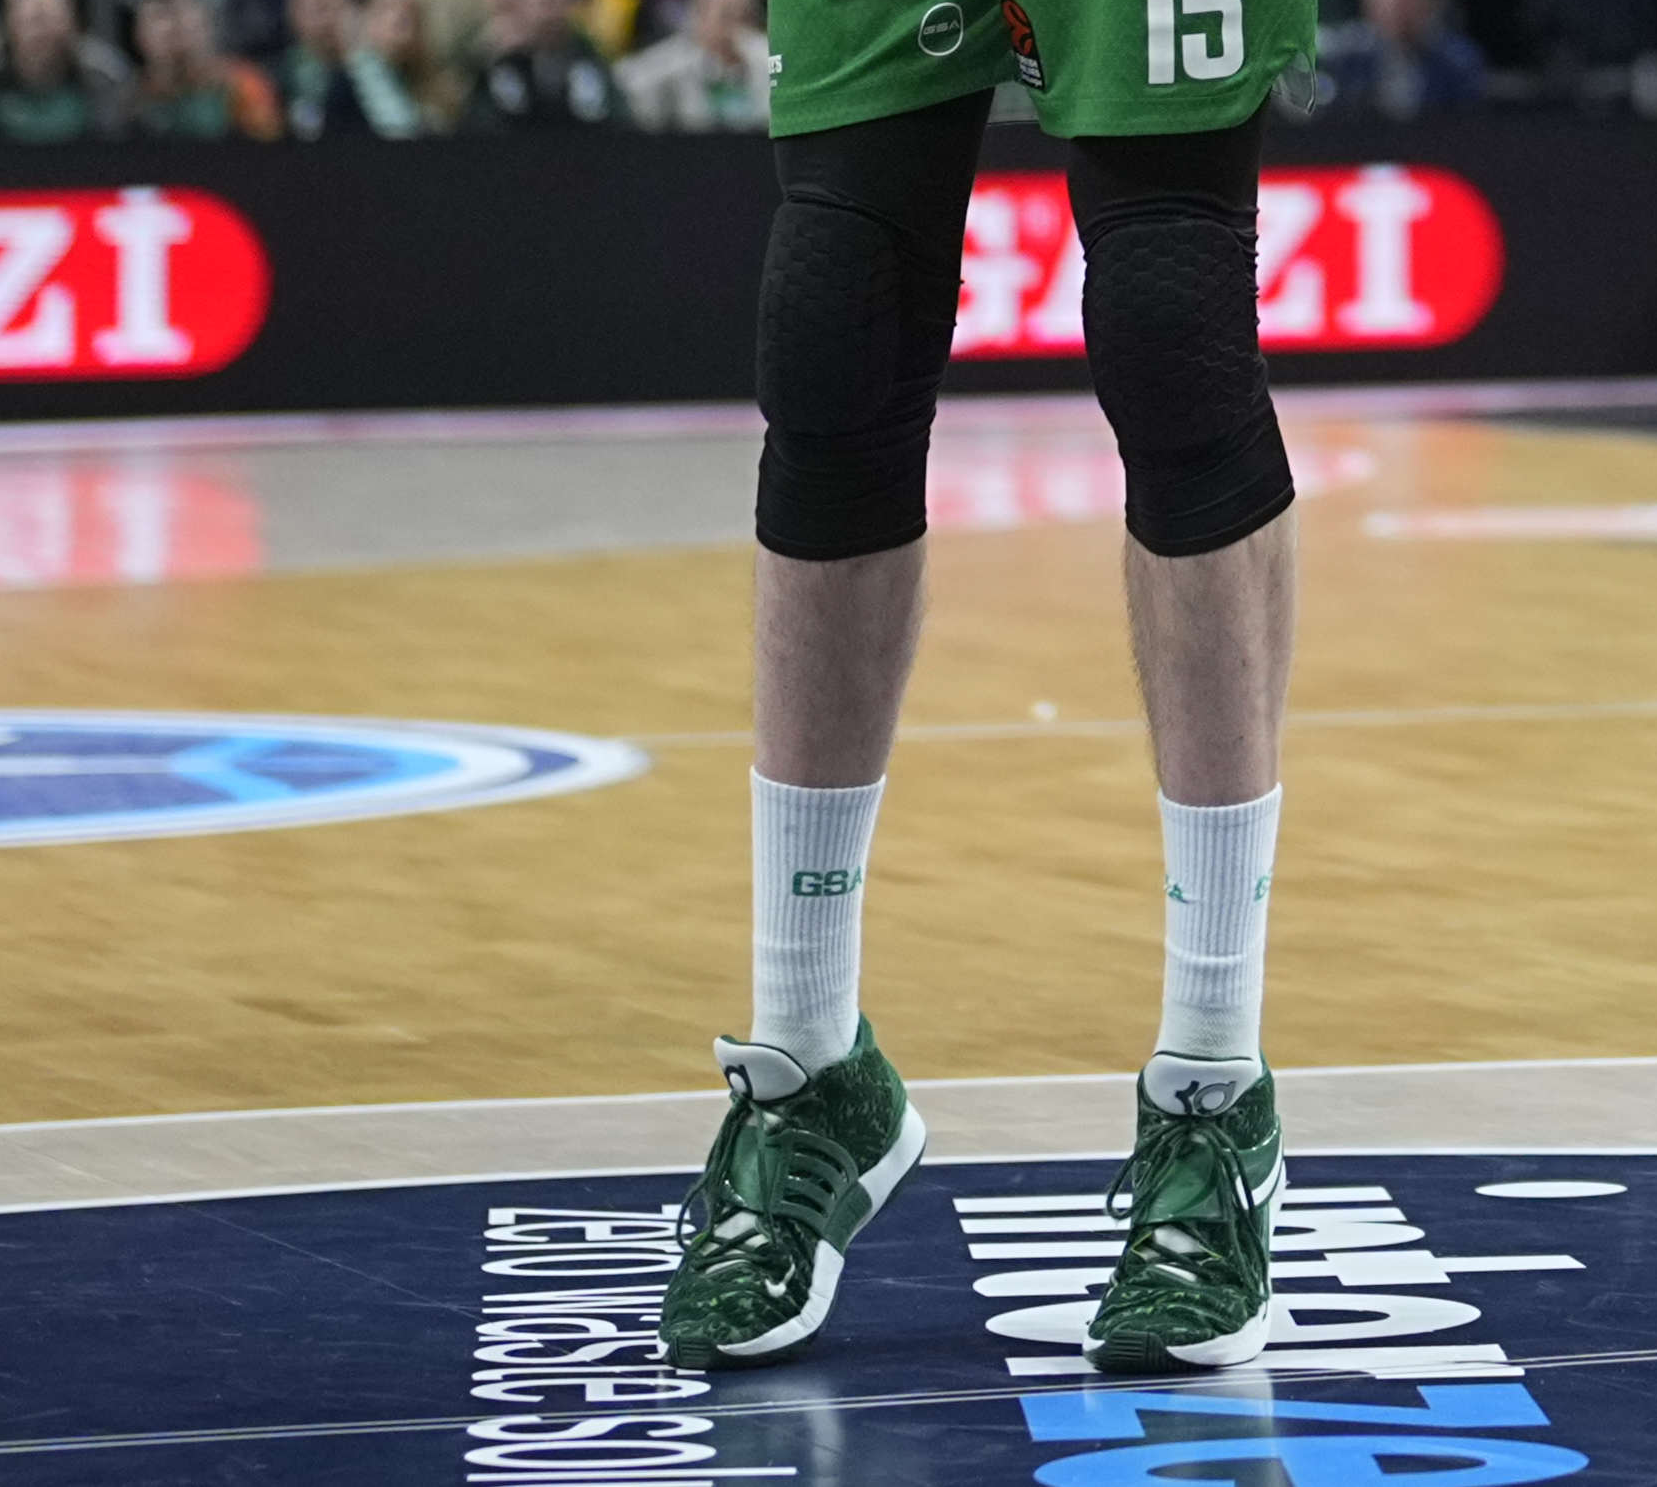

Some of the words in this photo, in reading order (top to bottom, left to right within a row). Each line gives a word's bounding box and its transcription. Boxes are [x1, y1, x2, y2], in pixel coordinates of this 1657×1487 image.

[480, 1203, 697, 1277] zero
[469, 1283, 712, 1403] waste
[463, 1414, 798, 1487] sol
